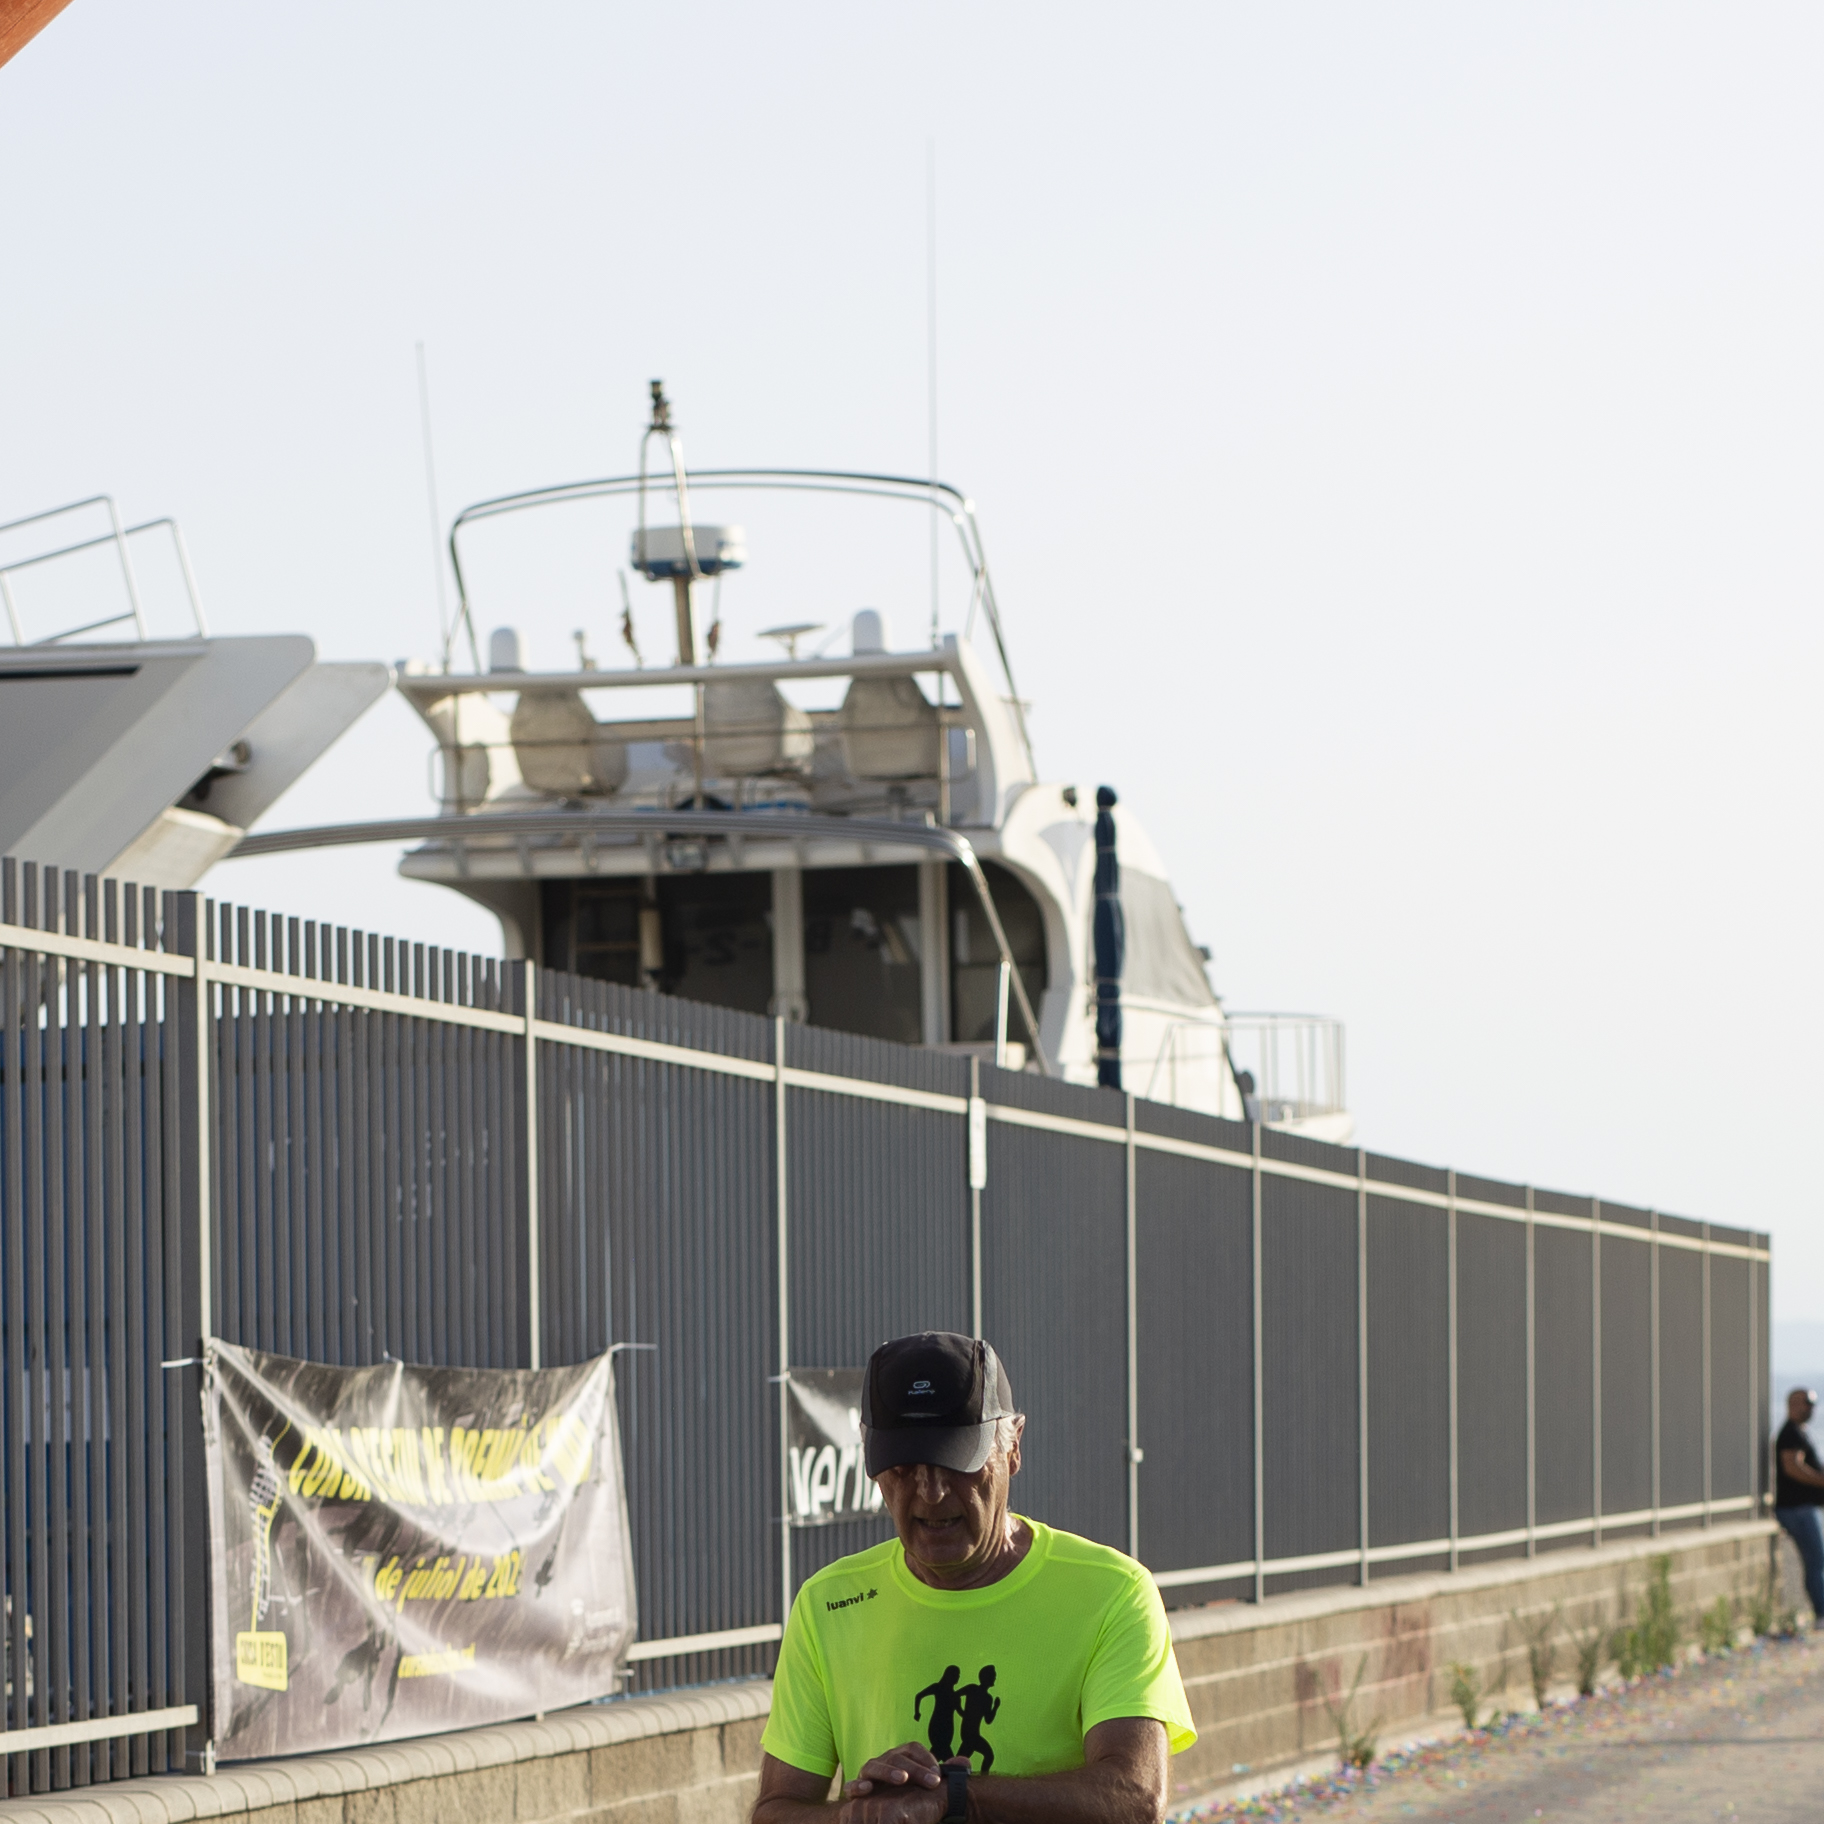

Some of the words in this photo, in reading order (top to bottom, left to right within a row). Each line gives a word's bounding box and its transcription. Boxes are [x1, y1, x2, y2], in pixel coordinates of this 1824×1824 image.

[376, 1555, 404, 1601] de
[396, 1556, 467, 1615] juliol
[460, 1555, 487, 1601] de
[826, 1592, 864, 1611] luanvi
